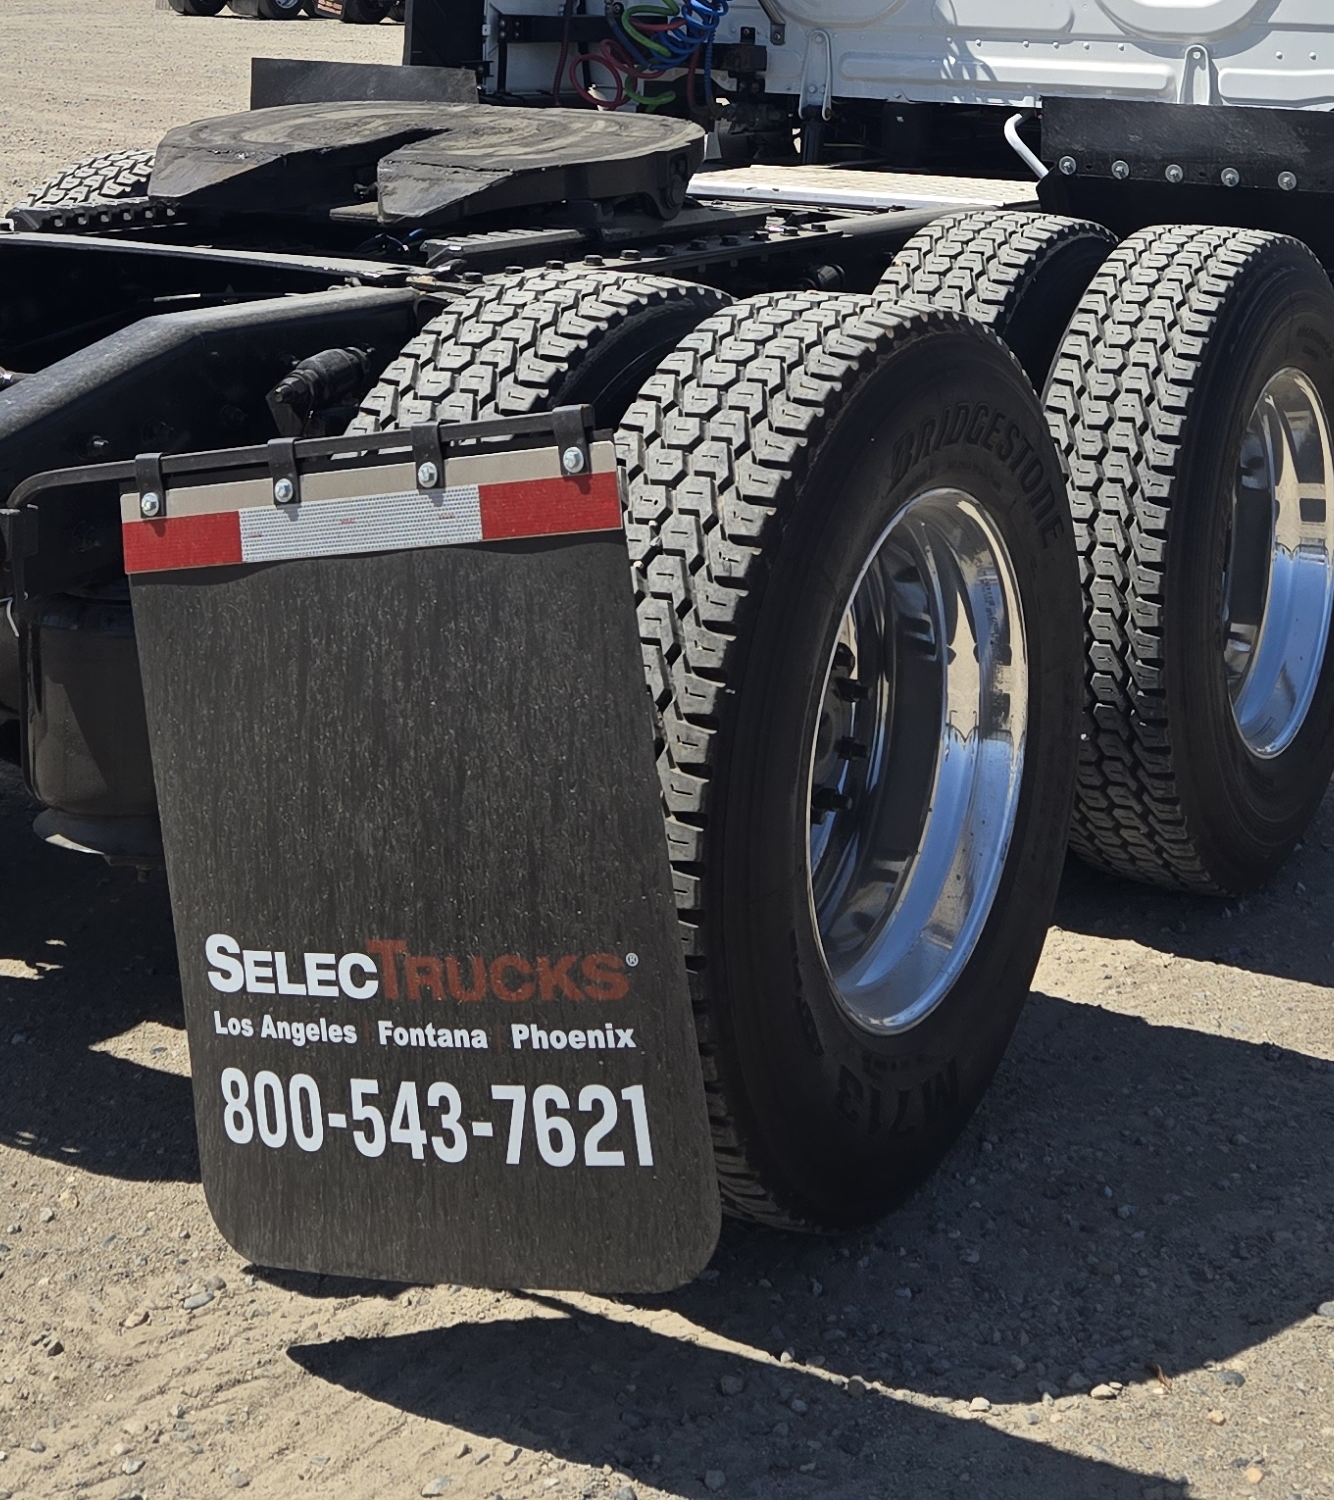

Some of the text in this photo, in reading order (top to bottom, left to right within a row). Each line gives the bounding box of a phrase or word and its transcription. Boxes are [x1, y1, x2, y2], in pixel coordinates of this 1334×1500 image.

[886, 399, 1065, 549] BRIDGESTONE
[213, 1010, 637, 1050] Los Angeles Fontana Phoenix
[220, 1066, 654, 1168] 800-543-7621
